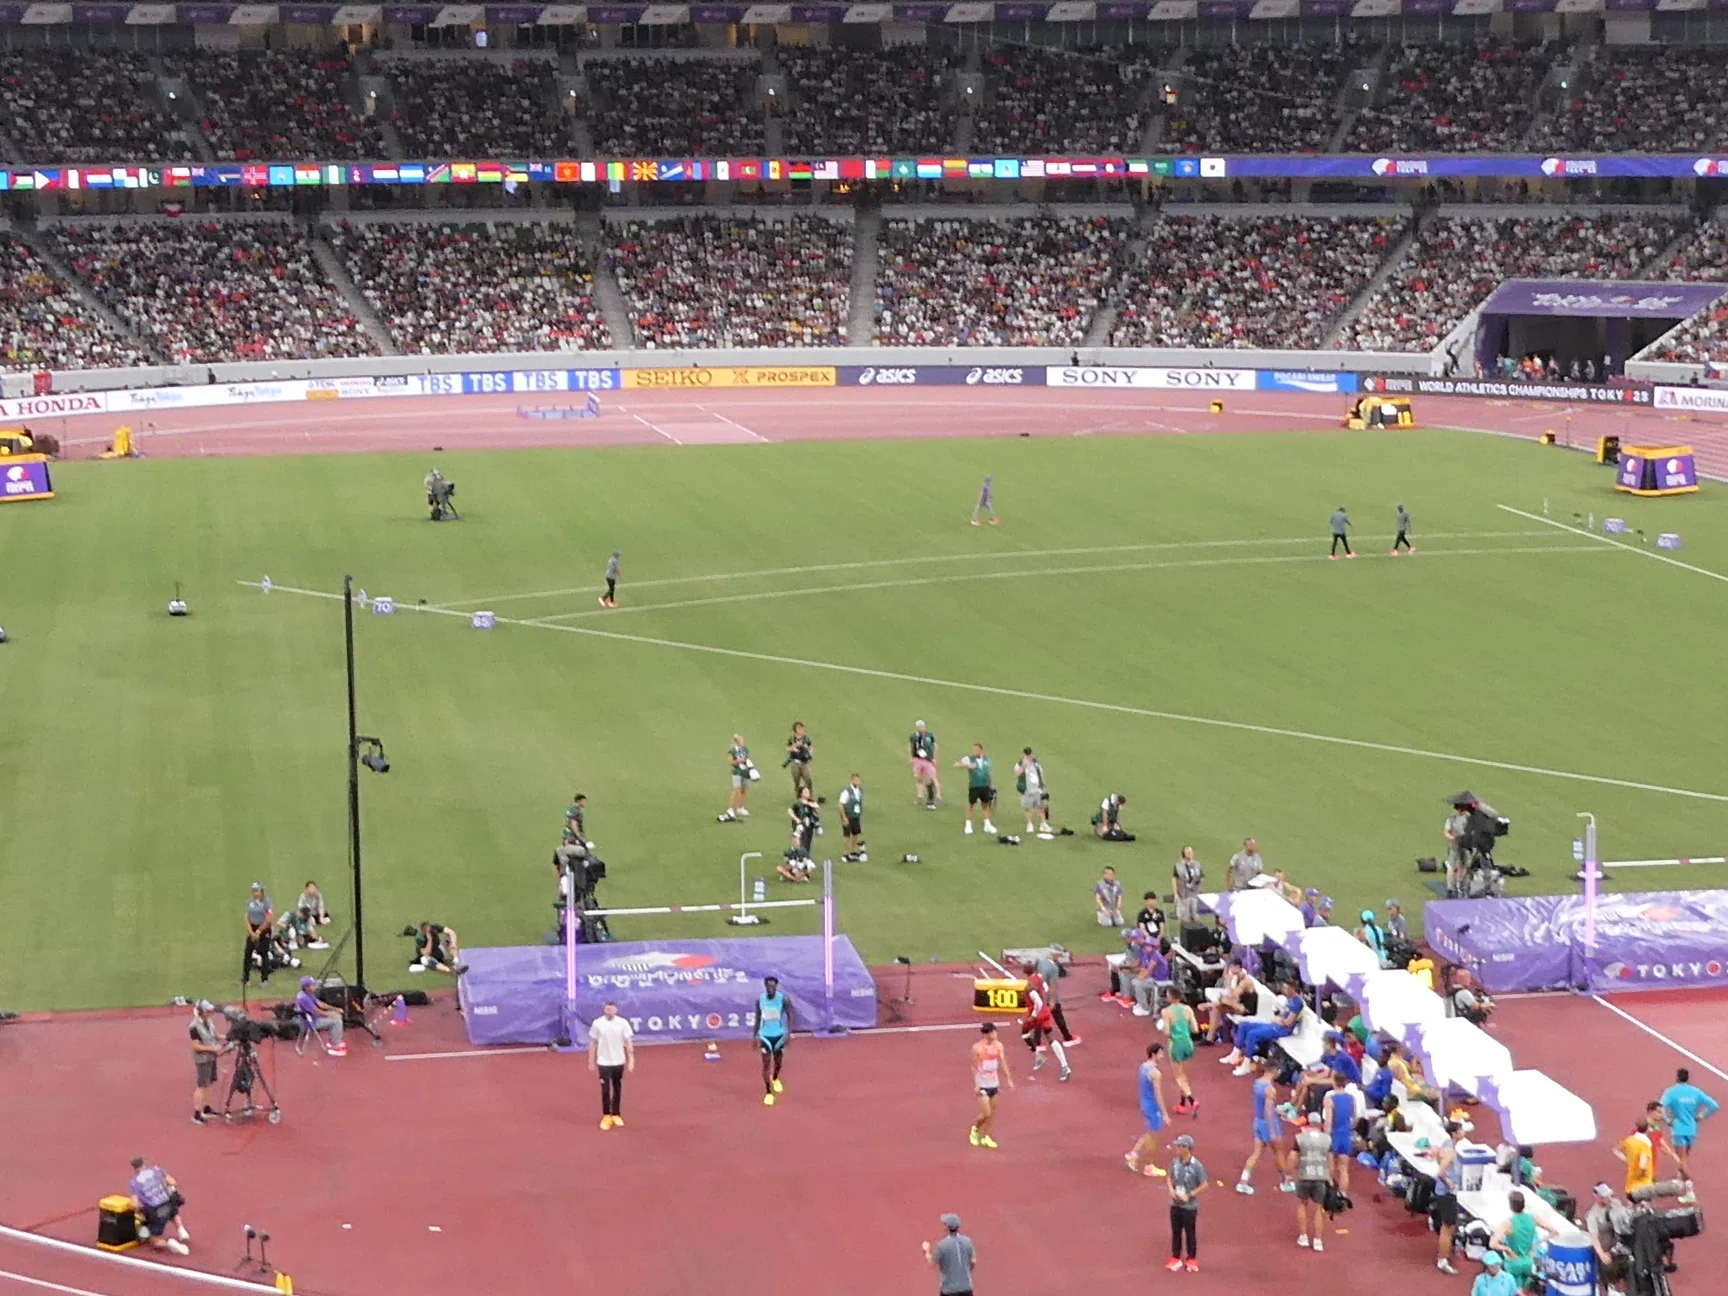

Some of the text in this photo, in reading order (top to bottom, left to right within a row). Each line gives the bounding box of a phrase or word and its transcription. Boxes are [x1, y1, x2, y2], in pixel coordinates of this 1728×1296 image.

[417, 375, 453, 394] TBS
[465, 373, 506, 392] TBS
[523, 371, 558, 389] TBS
[575, 370, 612, 389] TBS
[637, 371, 830, 386] SEIKO PROSPEX
[876, 368, 915, 383] asics
[983, 368, 1023, 383] asics
[1063, 369, 1137, 385] SONY
[1167, 371, 1241, 386] SONY
[1419, 381, 1453, 393] WORLD
[1455, 383, 1507, 396] ATHLETICS
[1508, 384, 1587, 400] CHAMPIONSHIPS
[17, 396, 101, 418] HONDA
